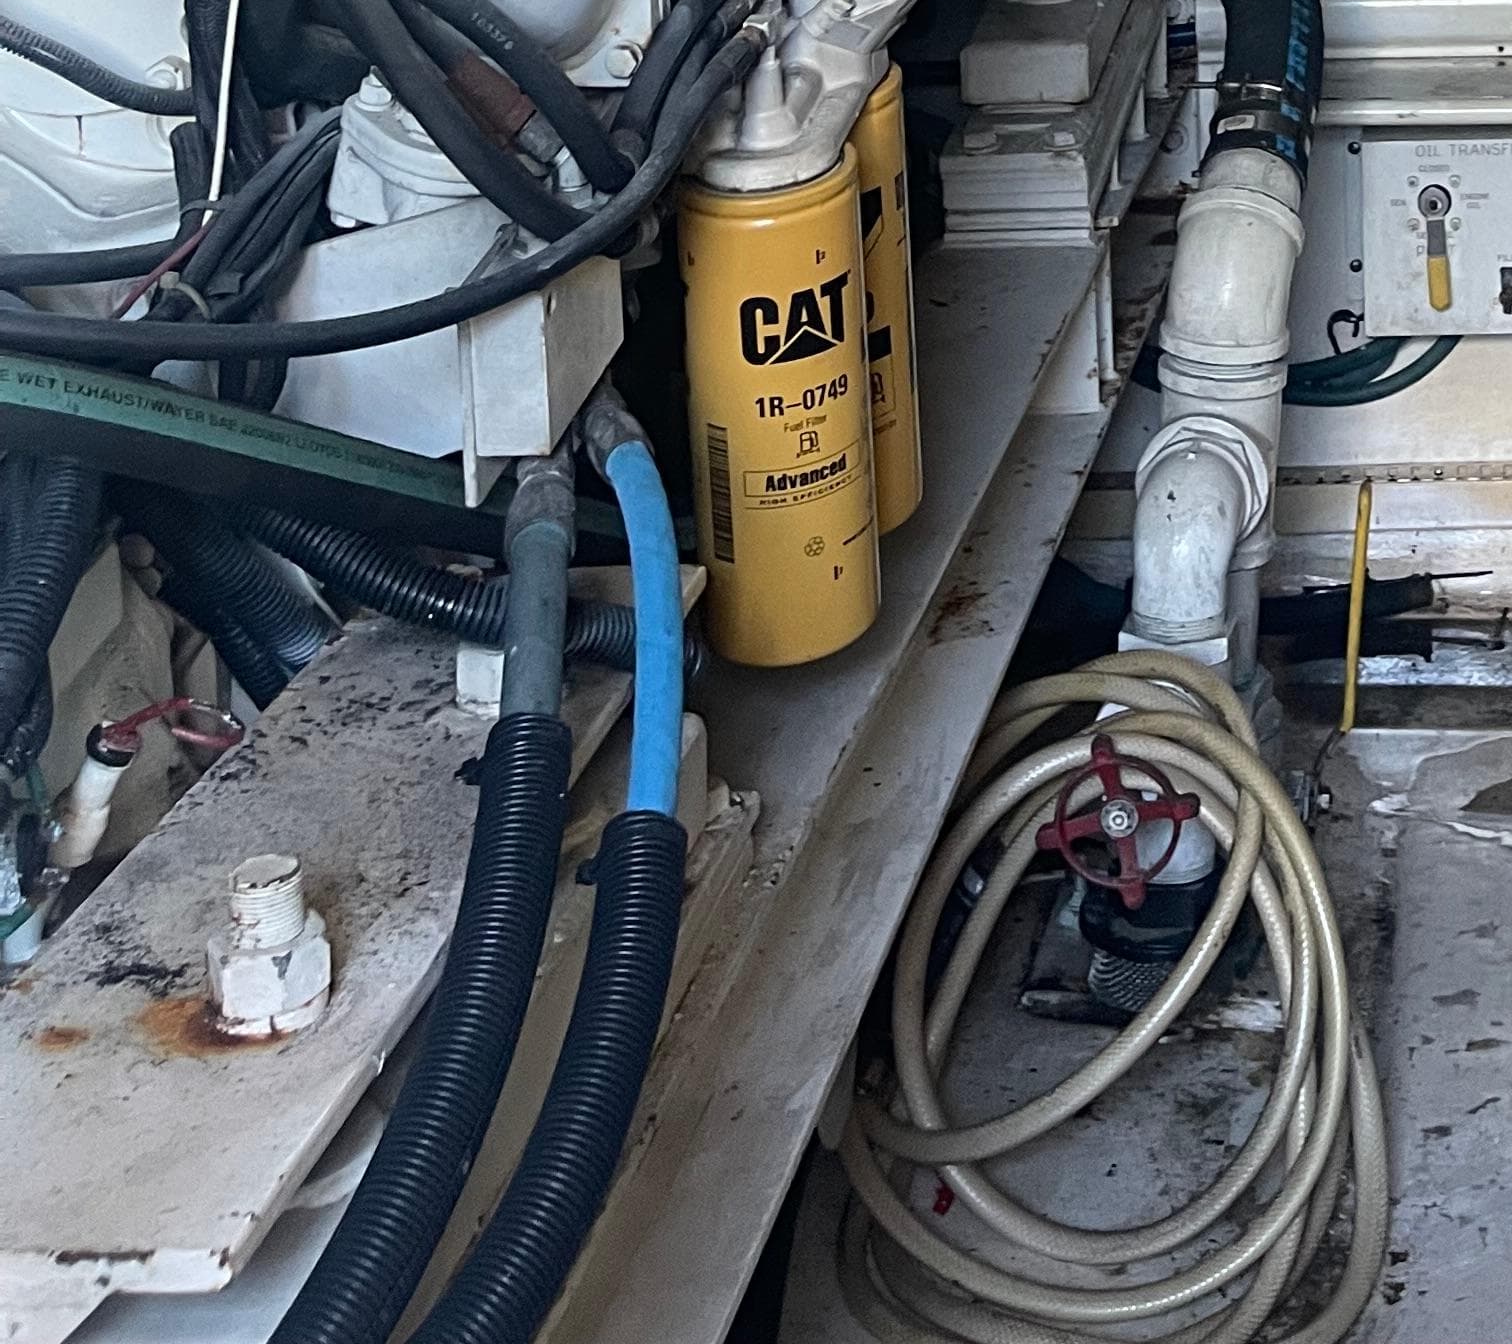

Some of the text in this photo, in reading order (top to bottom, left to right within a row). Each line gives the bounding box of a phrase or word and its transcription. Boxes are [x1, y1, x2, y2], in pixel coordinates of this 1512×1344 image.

[1415, 144, 1441, 157] OIL
[739, 270, 849, 366] CAT
[17, 372, 58, 390] WET
[64, 380, 205, 423] EXHAUST/WATER
[755, 374, 848, 418] 1R-0749
[765, 453, 847, 493] Advanced
